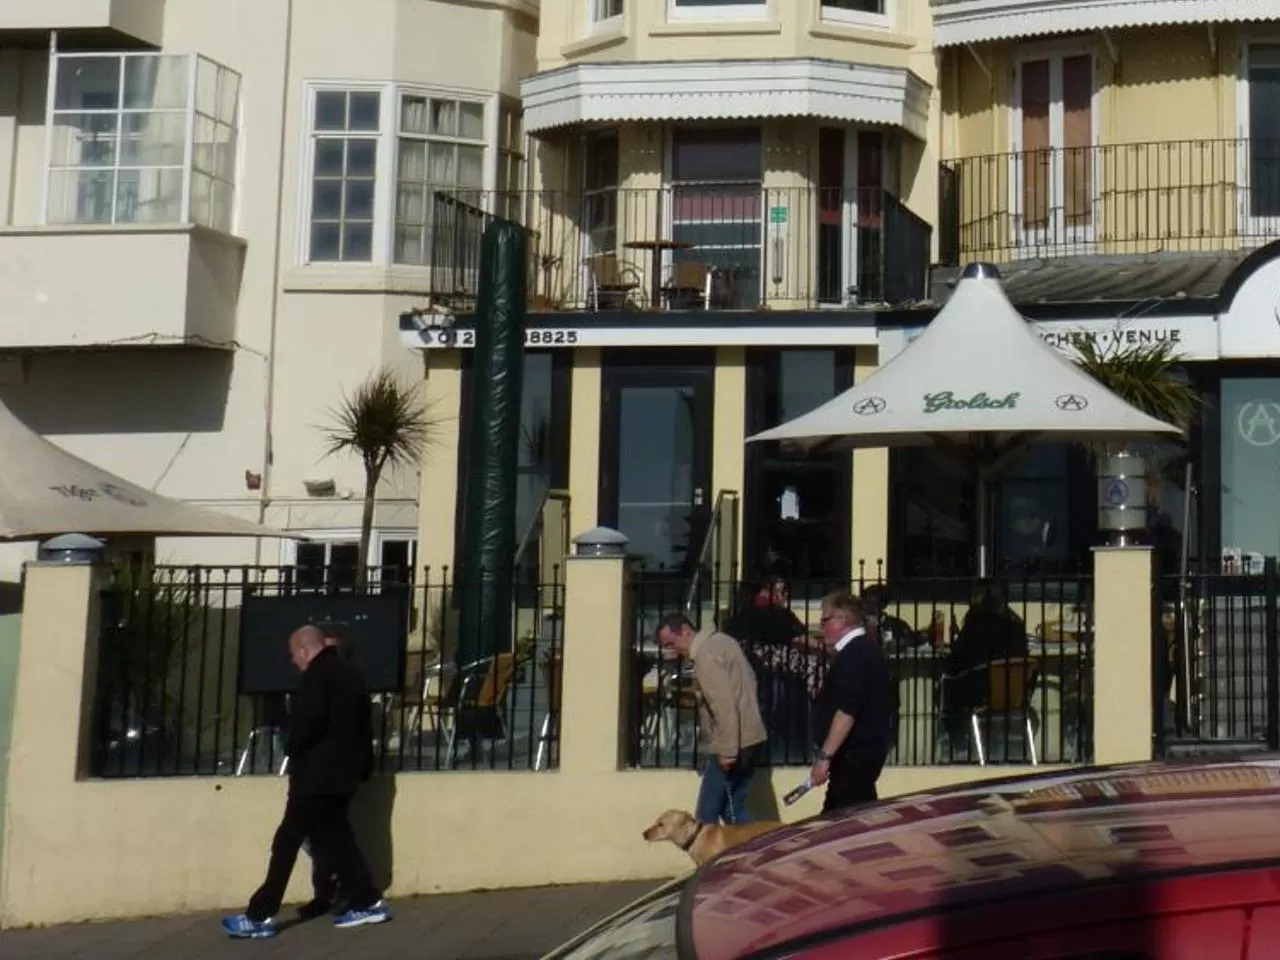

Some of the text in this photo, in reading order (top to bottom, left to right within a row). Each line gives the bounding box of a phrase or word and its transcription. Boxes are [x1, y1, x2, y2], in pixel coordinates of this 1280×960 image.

[524, 331, 578, 344] 8825
[1113, 329, 1181, 344] VENUE
[923, 391, 1020, 413] Grolsch
